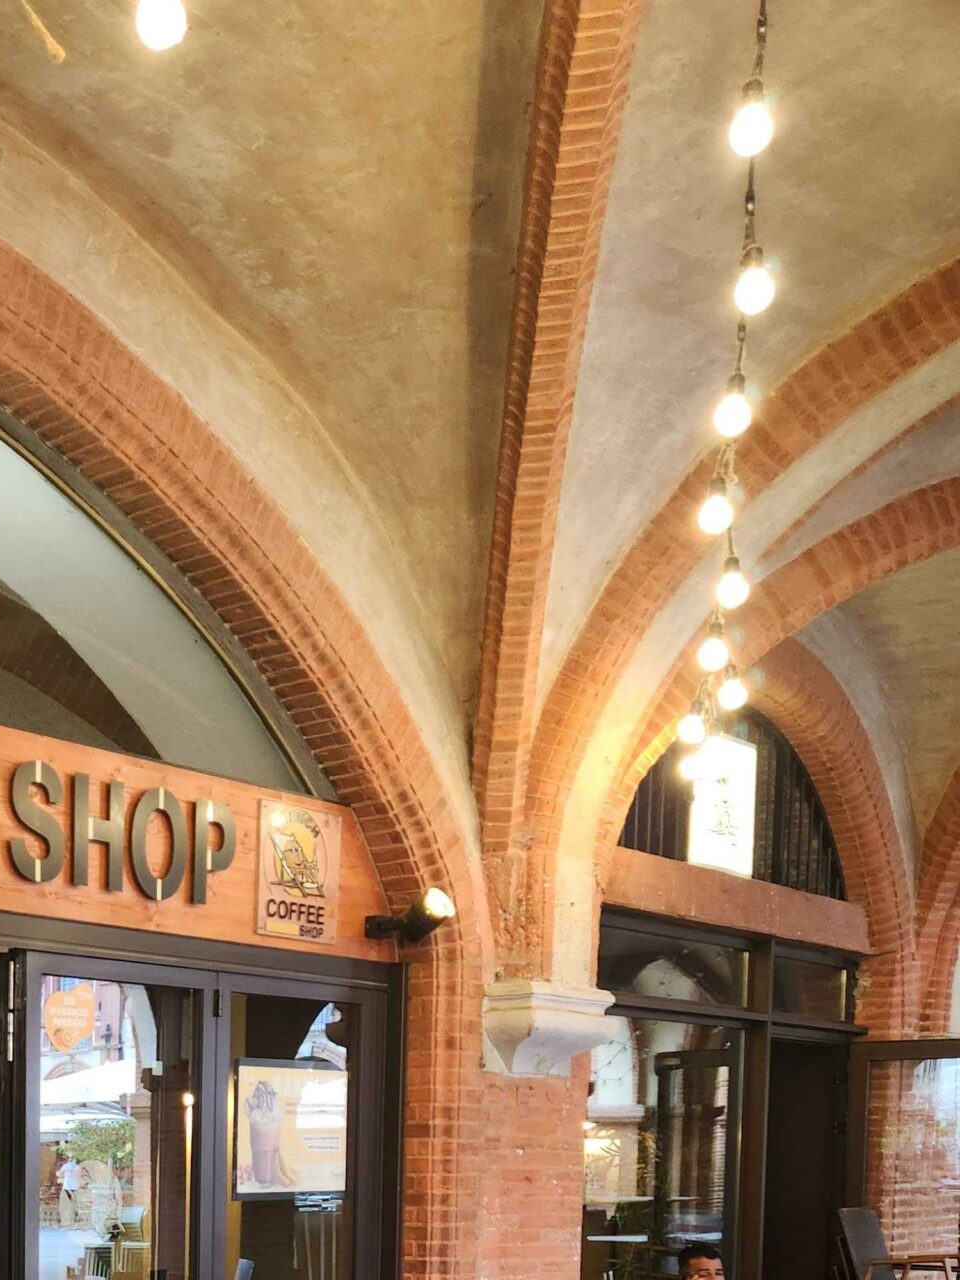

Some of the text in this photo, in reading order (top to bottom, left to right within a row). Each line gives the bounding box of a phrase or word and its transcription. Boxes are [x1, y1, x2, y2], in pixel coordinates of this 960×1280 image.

[9, 760, 236, 904] SHOP
[266, 898, 325, 925] COFFEE
[299, 924, 325, 939] SHOP
